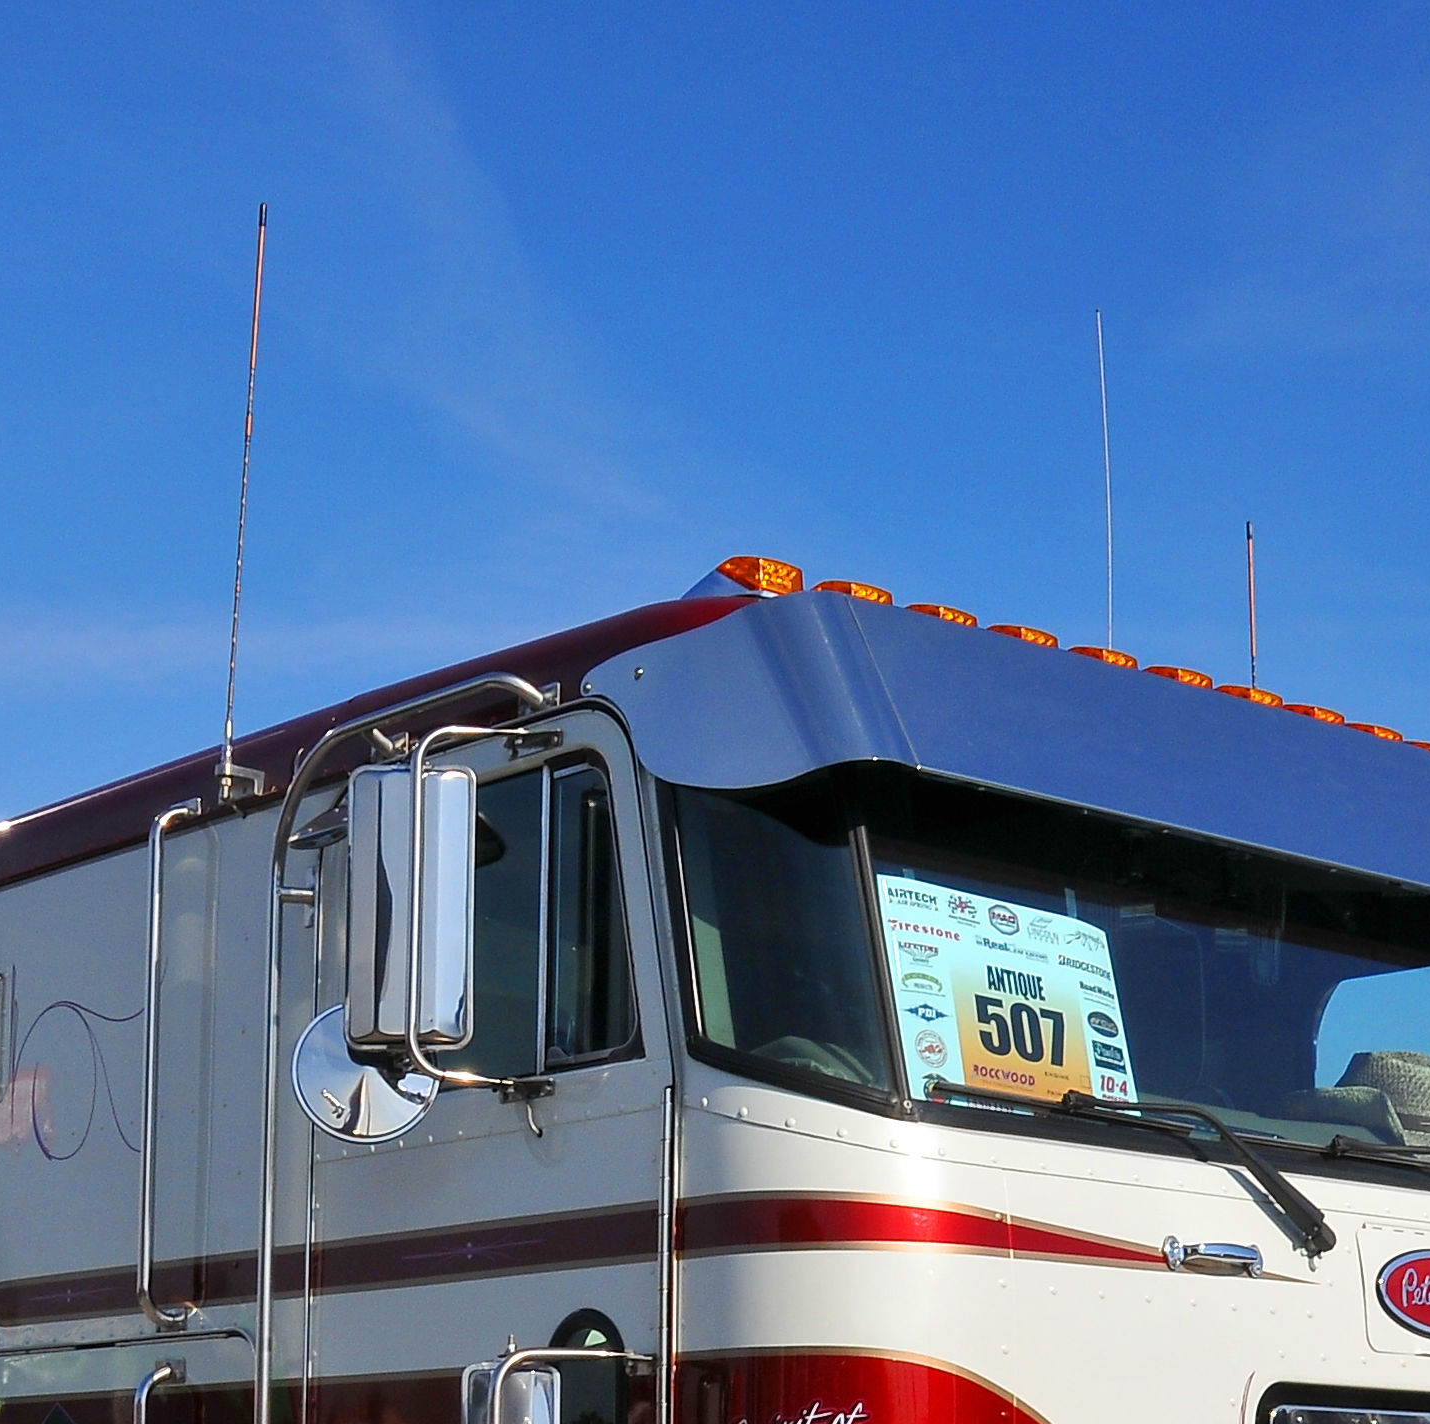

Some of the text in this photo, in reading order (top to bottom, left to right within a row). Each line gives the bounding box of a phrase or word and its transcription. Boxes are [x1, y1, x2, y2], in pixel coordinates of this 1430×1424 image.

[888, 888, 937, 905] AIRTECH
[888, 918, 961, 941] Firestone
[987, 965, 1046, 1001] ANTIQUE
[975, 994, 1065, 1066] 507
[973, 1064, 1036, 1086] ROCKWOOD
